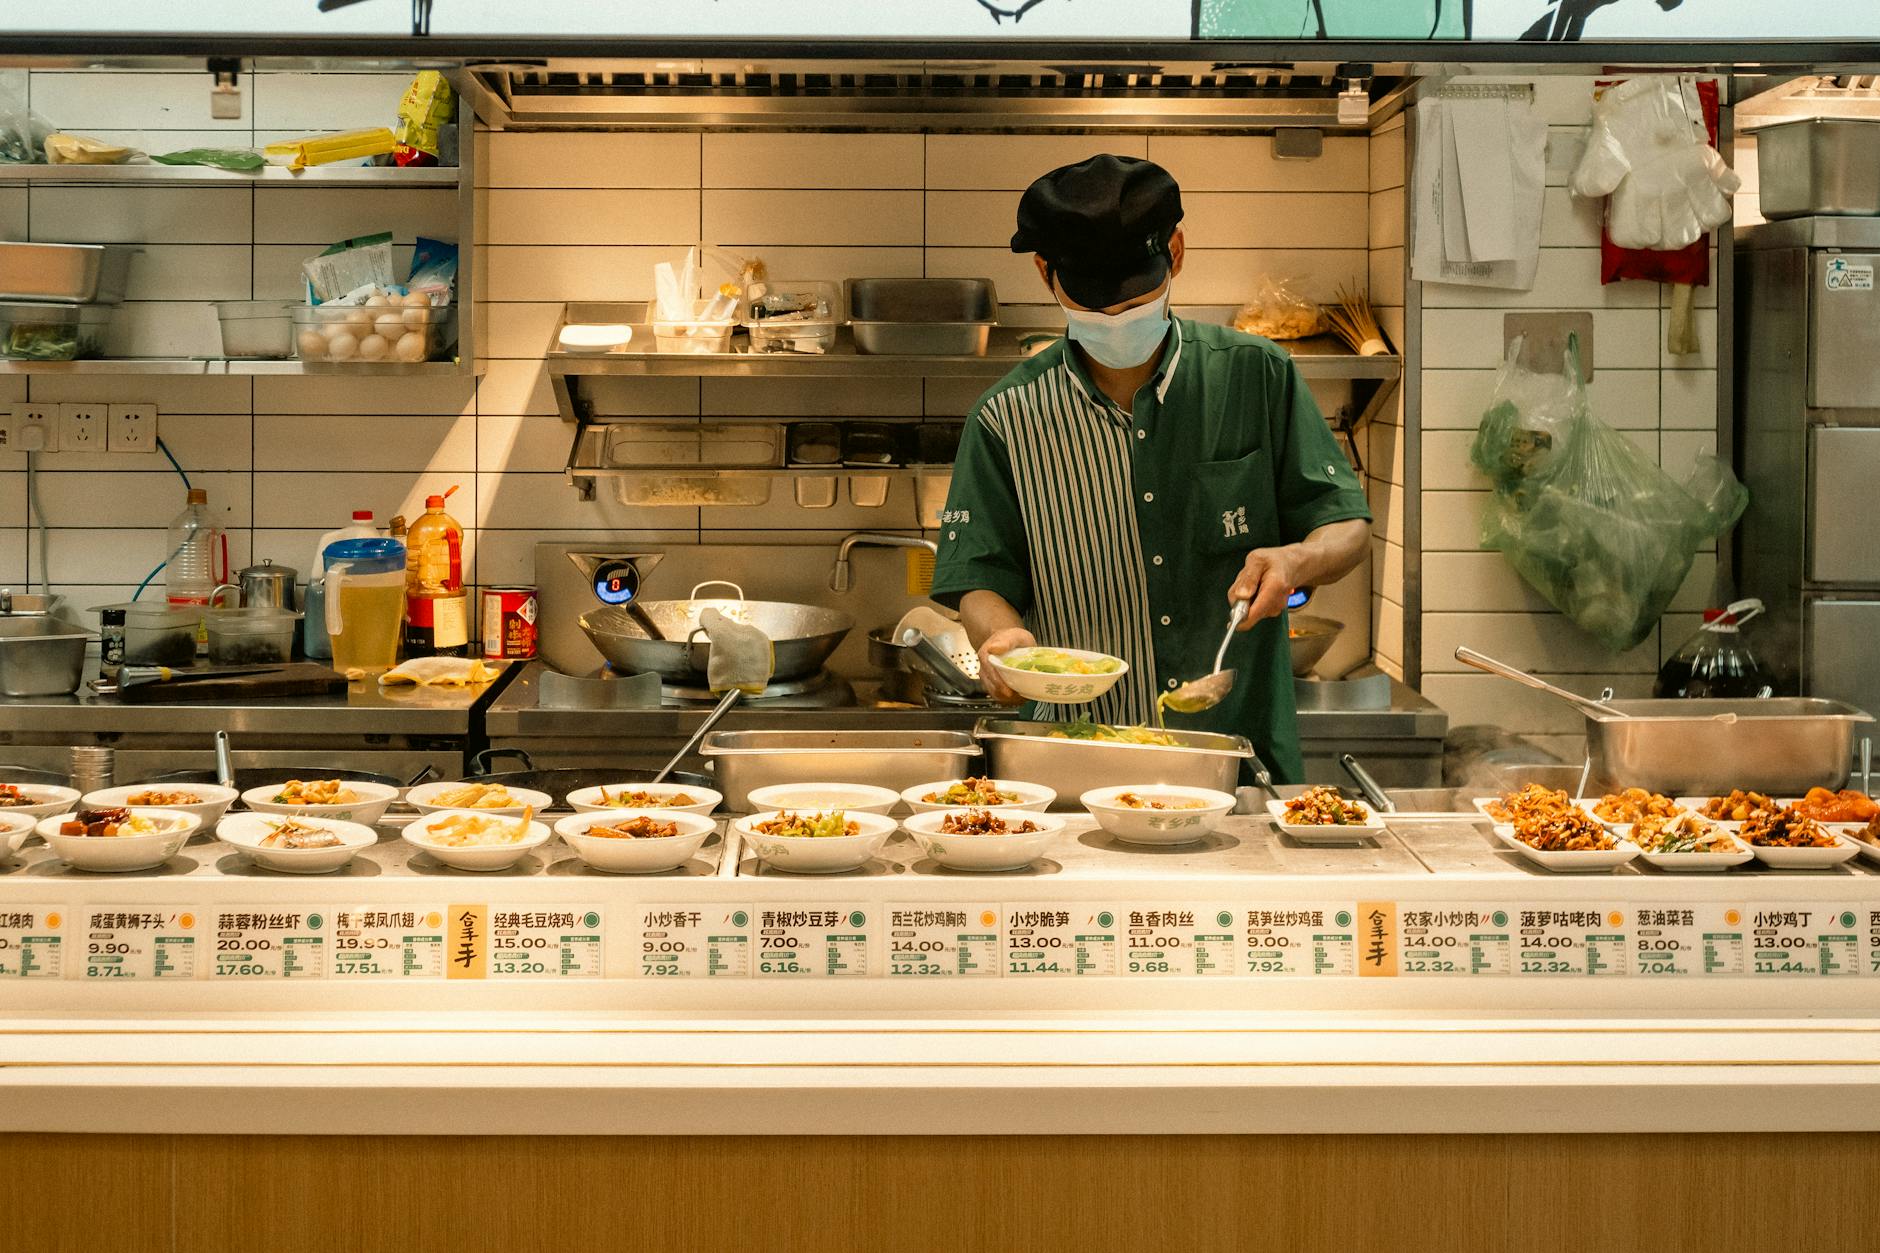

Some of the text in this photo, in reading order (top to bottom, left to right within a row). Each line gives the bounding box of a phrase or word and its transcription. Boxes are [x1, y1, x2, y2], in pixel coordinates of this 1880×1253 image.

[943, 510, 969, 523] 老乡鸡
[612, 579, 620, 591] 0
[1045, 683, 1094, 696] 老乡鸡
[1147, 815, 1200, 829] 老乡鸡
[90, 913, 165, 930] 咸蛋黄狮子头
[218, 913, 301, 930] 蒜蓉粉丝虾
[494, 912, 574, 929] 经典毛豆烧鸡
[643, 912, 702, 928] 小炒香干
[761, 911, 839, 928] 青椒炒豆芽
[892, 911, 967, 927] 西兰花炒鸡胸肉
[1010, 911, 1070, 928] 小炒脆笋
[1129, 911, 1194, 928] 鱼香肉丝
[1247, 911, 1323, 927] 莴笋丝炒鸡蛋
[1404, 911, 1479, 927] 农家小炒肉
[1521, 911, 1601, 927] 菠萝咕咾肉
[1637, 910, 1694, 926] 葱油菜苔
[1754, 911, 1812, 928] 小炒鸡丁
[455, 911, 479, 968] 拿手
[494, 938, 546, 949] 15.00
[760, 937, 798, 948] 7.00
[1009, 937, 1062, 948] 13.00
[1129, 937, 1180, 948] 11.00
[1248, 937, 1289, 948] 9.00
[1366, 910, 1389, 966] 拿手
[1404, 936, 1456, 947] 14.00
[1520, 937, 1573, 948] 14.00
[1754, 937, 1805, 948] 13.00
[88, 943, 130, 954] 9.90
[217, 939, 270, 951] 20.00
[643, 942, 685, 953] 9.00
[891, 941, 944, 952] 14.00
[1638, 940, 1679, 951] 8.00
[87, 966, 124, 977] 8.71
[216, 964, 264, 976] 17.60
[335, 963, 381, 974] 17.51
[493, 963, 544, 974] 13.20
[642, 965, 679, 976] 7.92
[760, 962, 799, 973] 6.16
[891, 964, 940, 975] 12.32
[1009, 962, 1059, 973] 11.44
[1129, 962, 1169, 973] 9.68
[1247, 962, 1284, 972] 7.92
[1404, 961, 1454, 972] 12.32
[1521, 962, 1570, 973] 12.32
[1638, 963, 1676, 974] 7.04
[1755, 962, 1804, 973] 11.44
